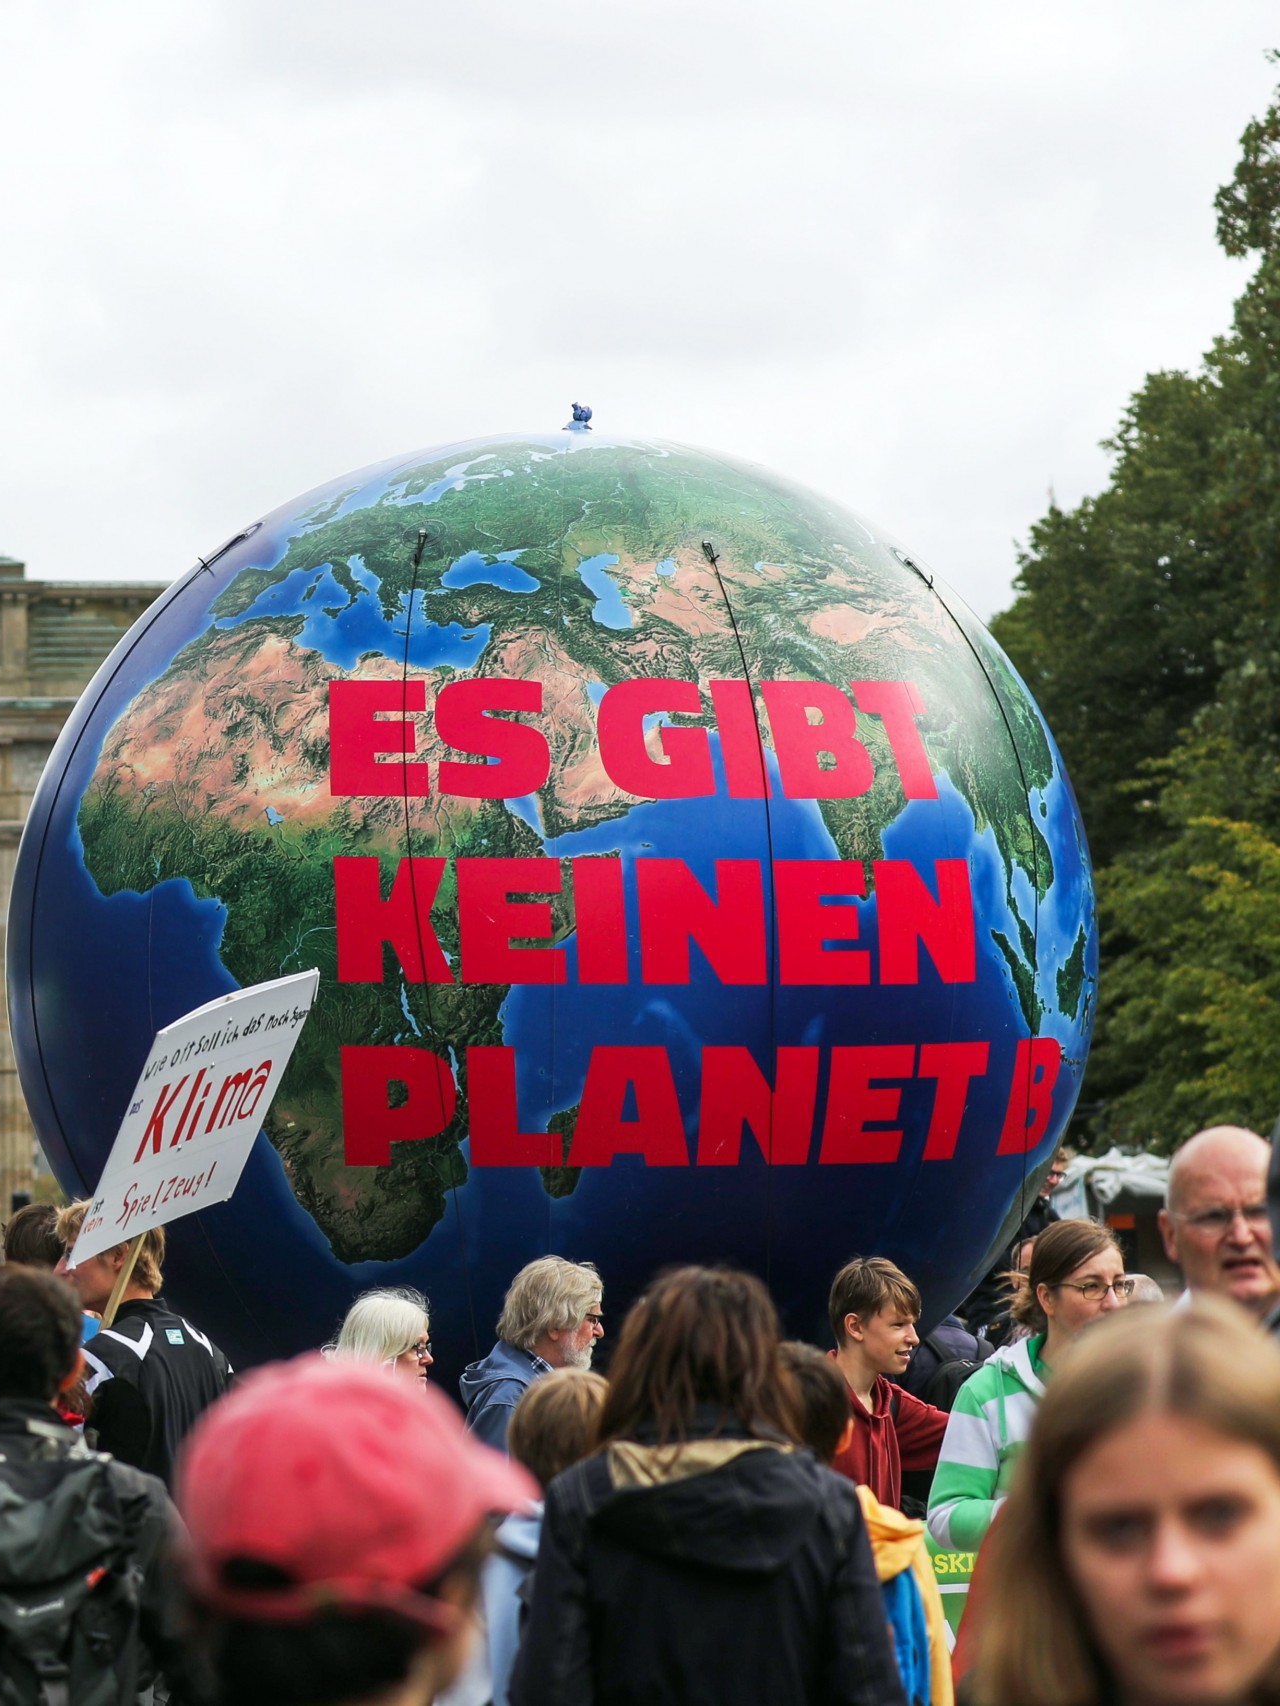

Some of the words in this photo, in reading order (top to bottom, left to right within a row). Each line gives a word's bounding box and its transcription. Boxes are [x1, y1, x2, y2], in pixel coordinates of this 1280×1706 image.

[329, 678, 550, 799] ES
[597, 678, 938, 800] GIBT
[334, 857, 976, 985] KEINEN
[220, 1022, 239, 1047] ich
[133, 1059, 272, 1164] Klima
[340, 1041, 989, 1168] PLANET
[996, 1037, 1062, 1156] B
